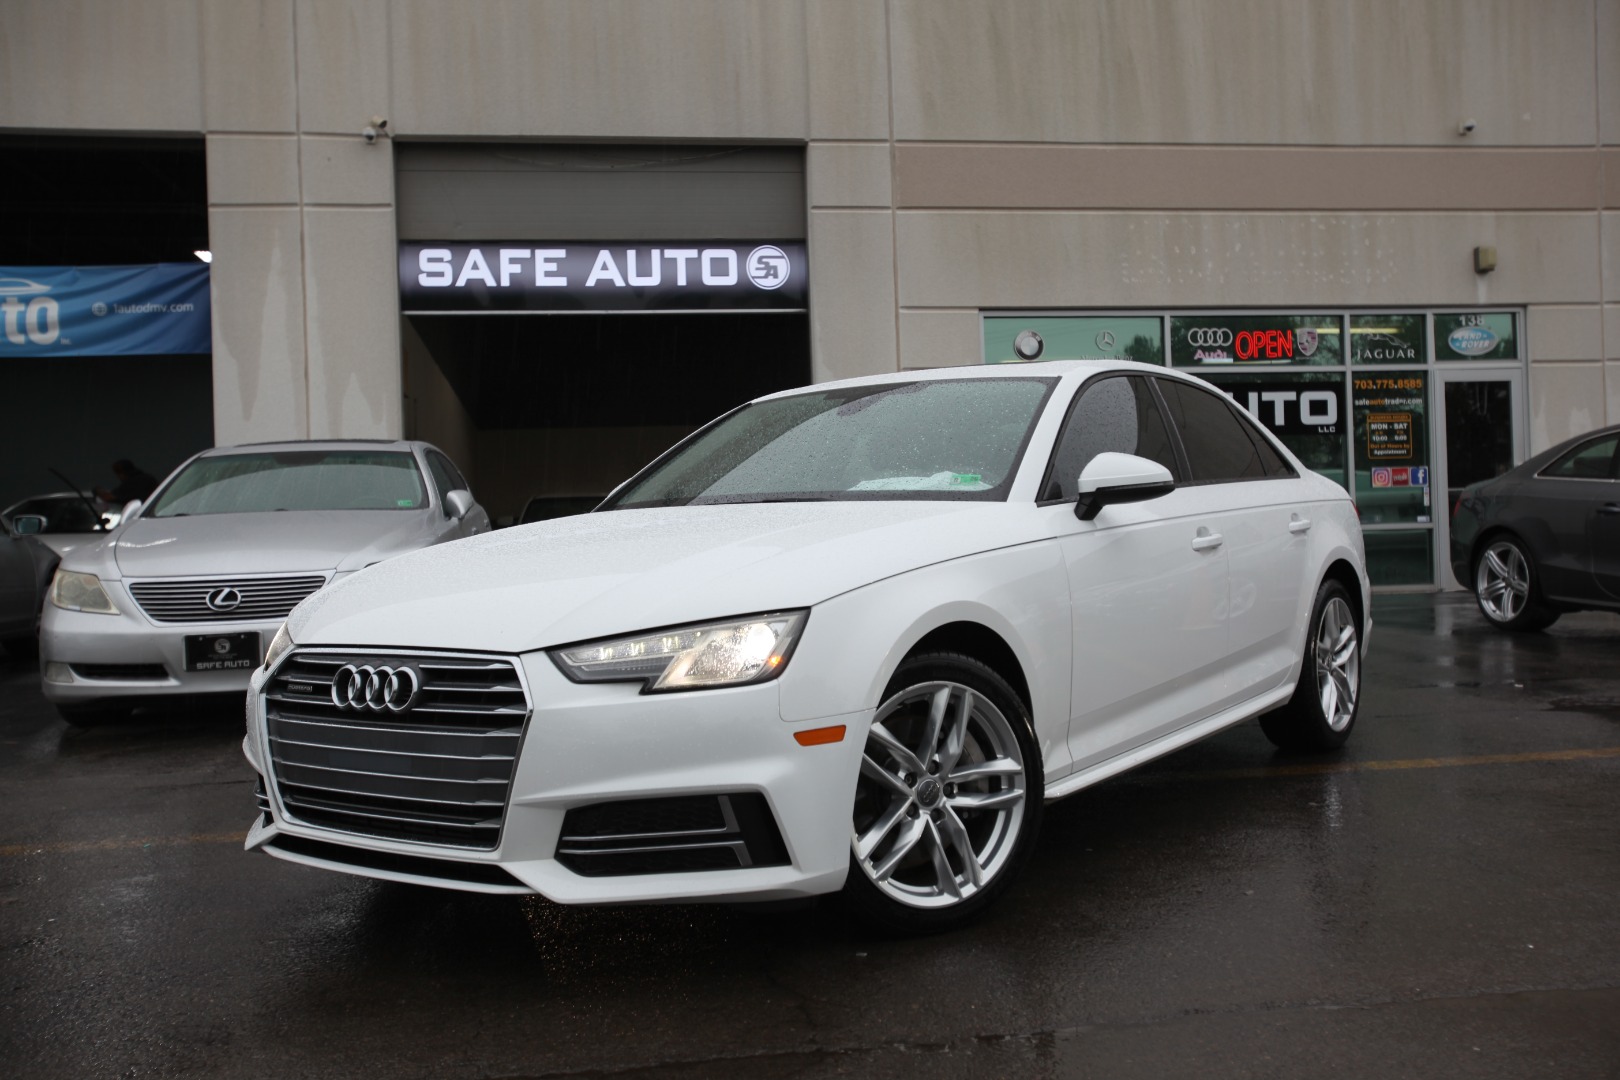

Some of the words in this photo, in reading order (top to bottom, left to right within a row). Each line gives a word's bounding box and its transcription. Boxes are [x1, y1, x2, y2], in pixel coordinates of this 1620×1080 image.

[418, 248, 568, 287] SAFE
[585, 248, 738, 287] AUTO
[113, 301, 194, 314] 1autodmv.com
[1235, 329, 1293, 359] OPEN
[1462, 340, 1491, 349] ROVER
[1193, 349, 1228, 360] Audi
[1356, 348, 1416, 360] JAGUAR
[224, 659, 250, 668] AUTO
